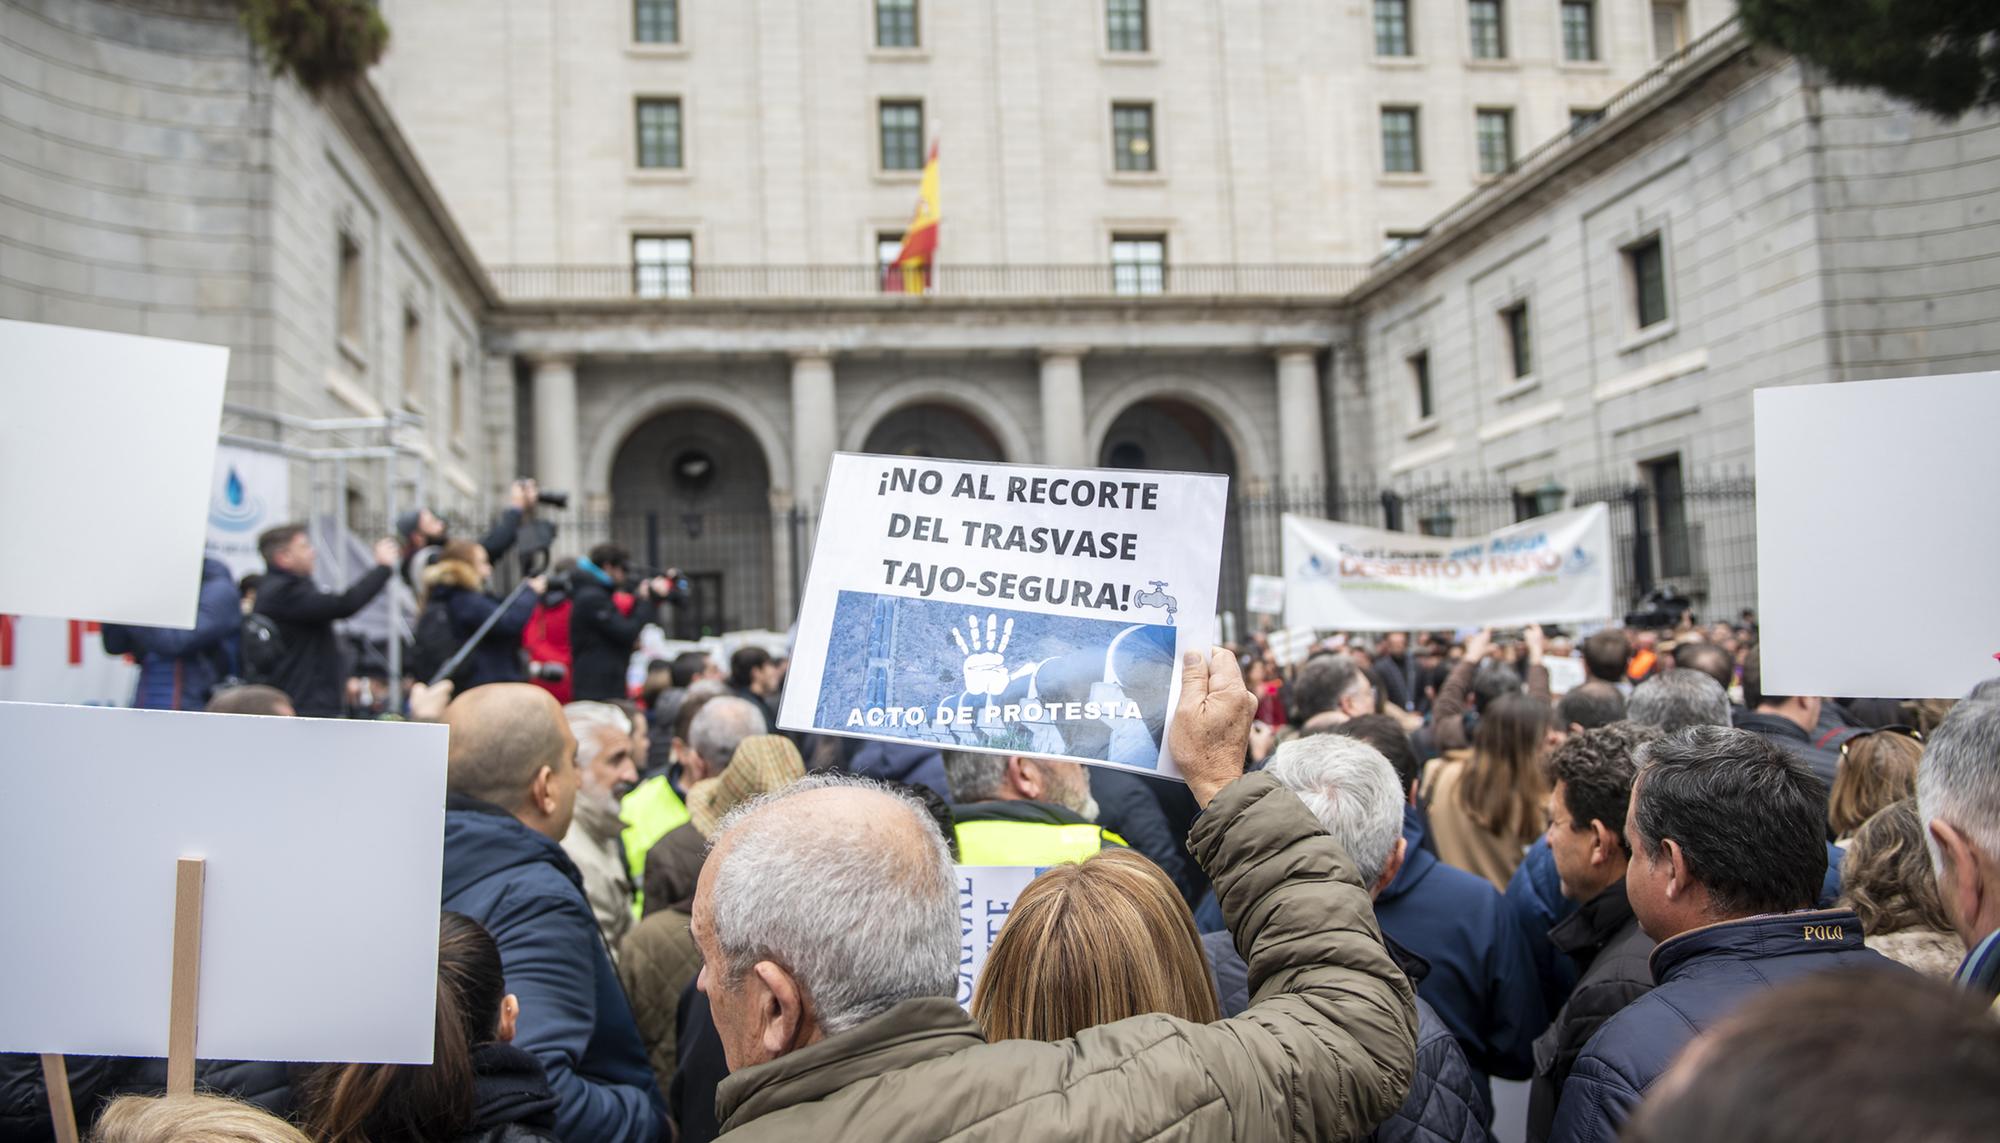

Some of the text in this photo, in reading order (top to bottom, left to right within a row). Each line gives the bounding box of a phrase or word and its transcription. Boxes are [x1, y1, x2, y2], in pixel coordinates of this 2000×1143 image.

[878, 467, 1160, 511] ¡NO AL RECORTE
[887, 512, 1138, 561] DEL TRASVASE
[882, 559, 1131, 613] TAJO-SEGURA!
[847, 701, 1143, 727] ACTO DE PROTESTA
[1803, 924, 1843, 941] POLO
